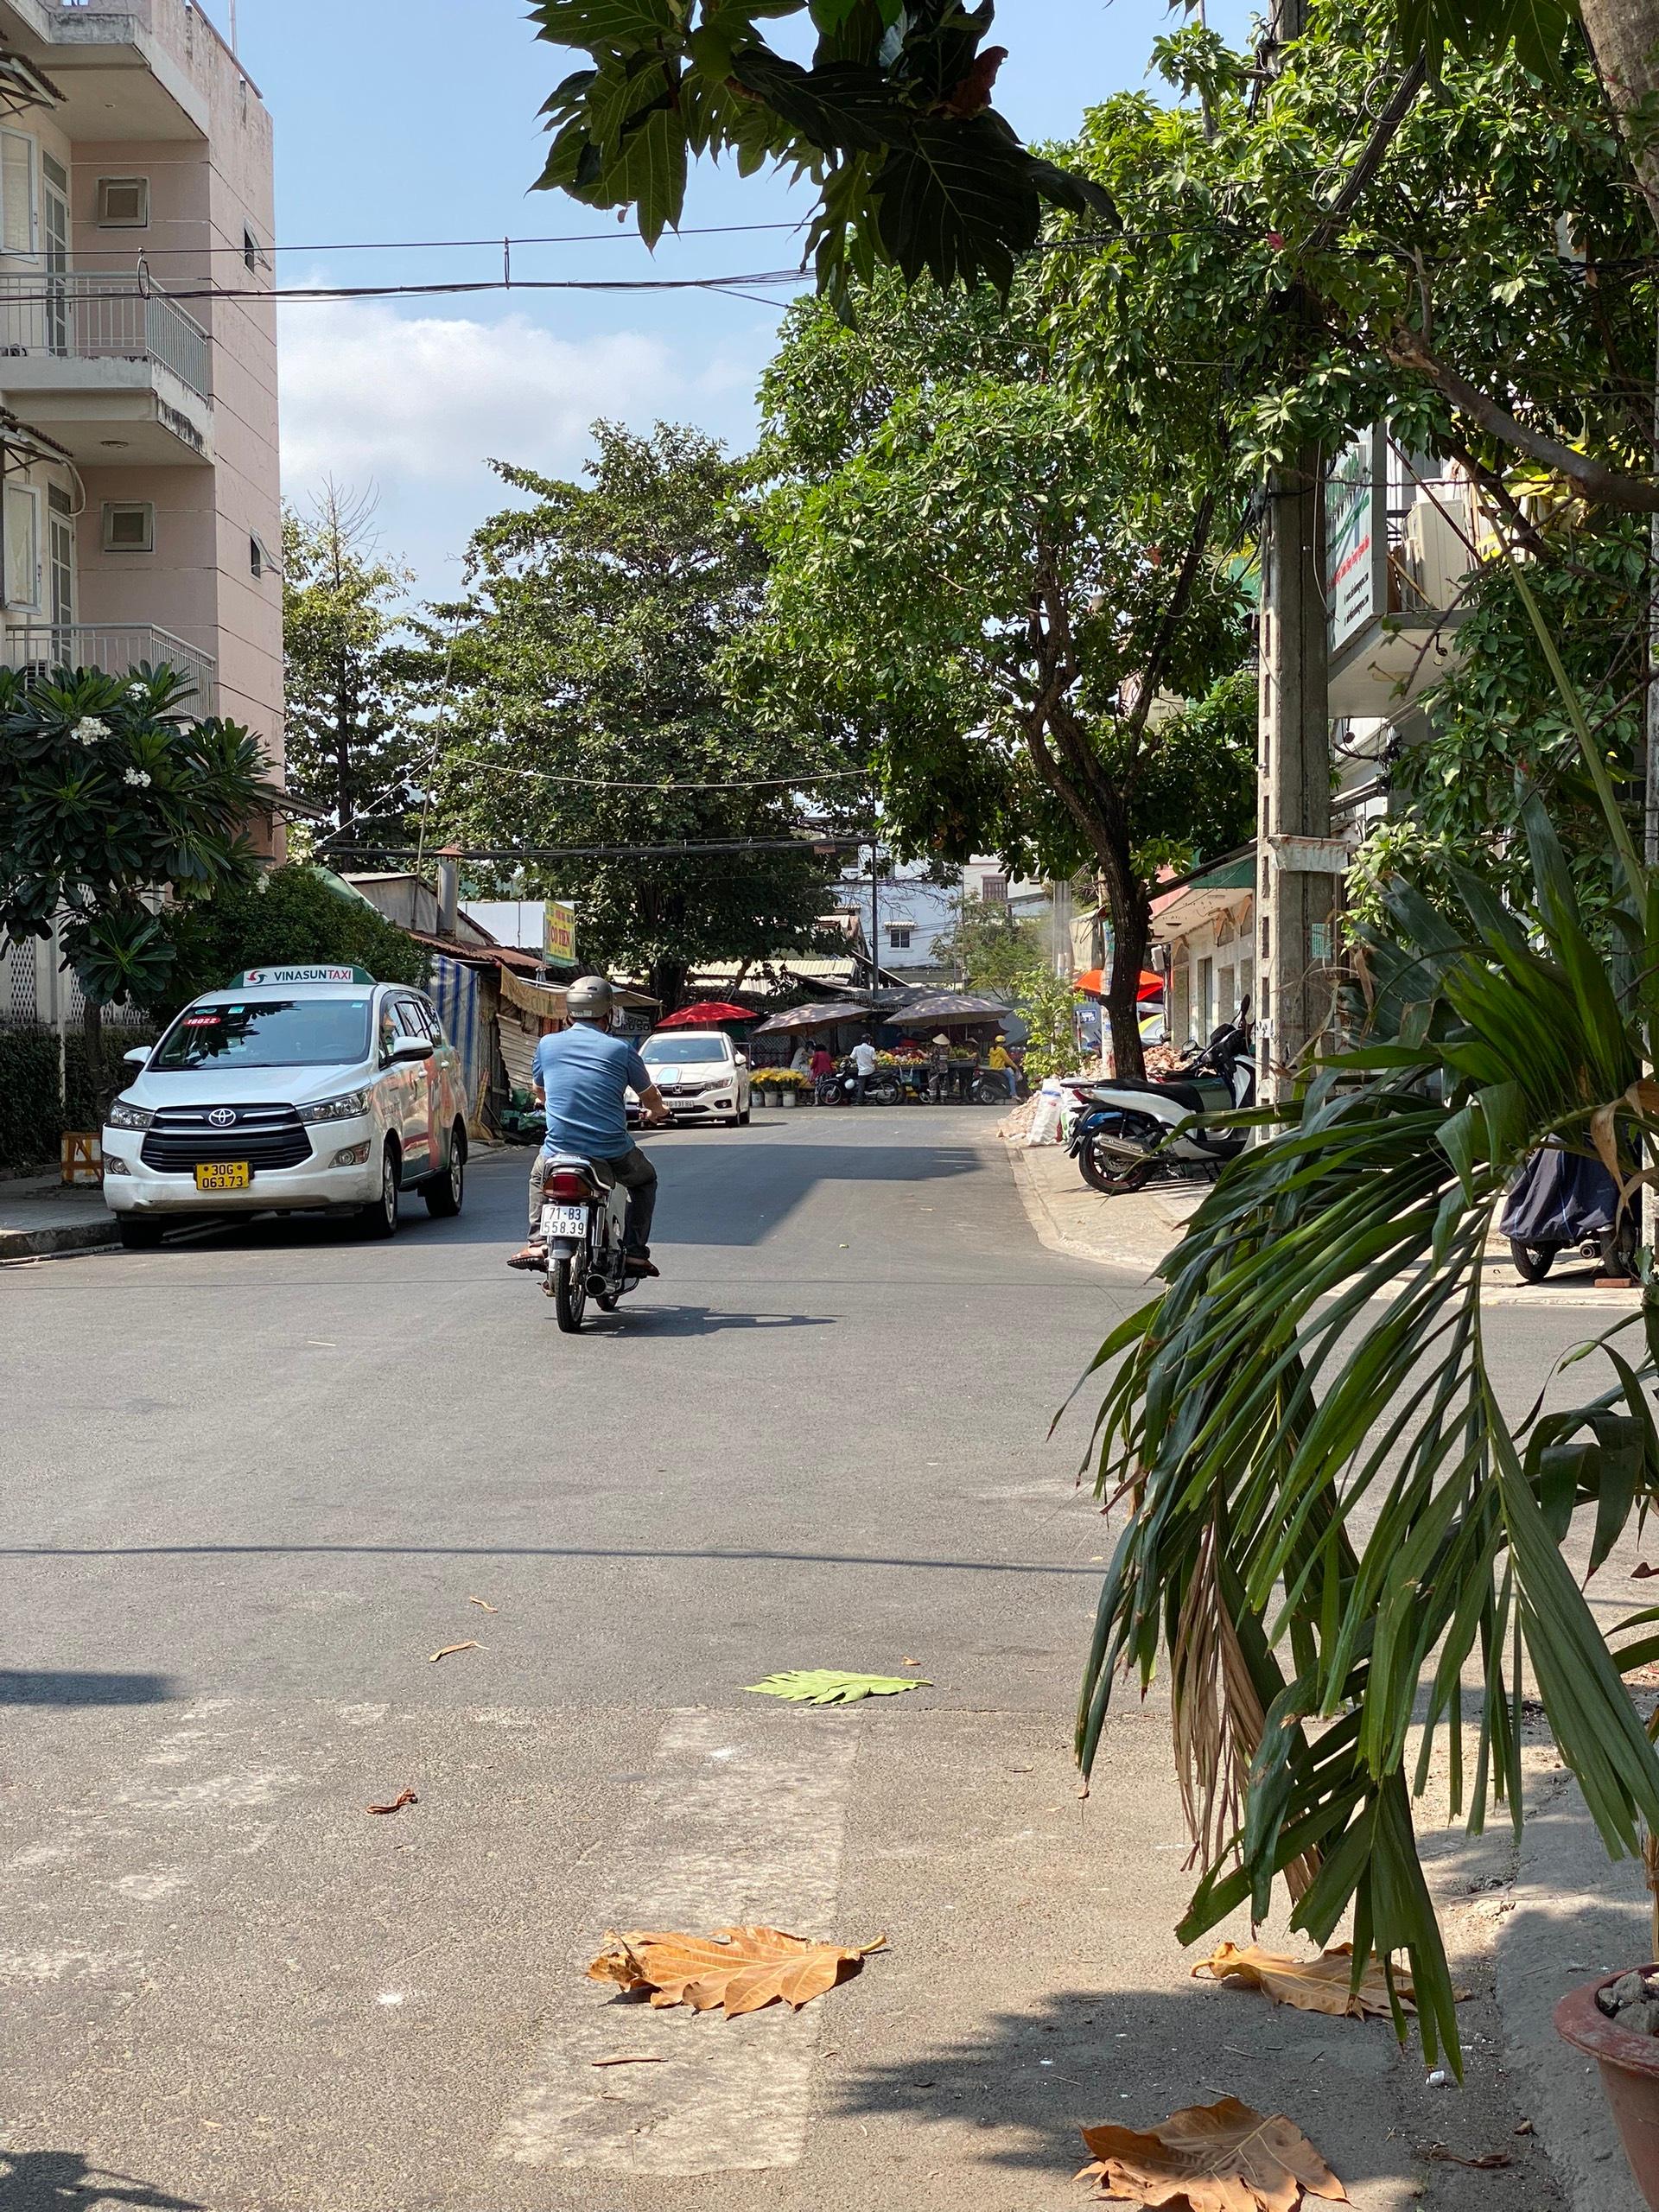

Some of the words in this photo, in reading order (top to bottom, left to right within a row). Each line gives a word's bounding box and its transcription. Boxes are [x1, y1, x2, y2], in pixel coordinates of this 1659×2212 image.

[211, 1164, 234, 1176] 30G
[202, 1176, 244, 1188] 063.73
[543, 1221, 585, 1235] 558.39
